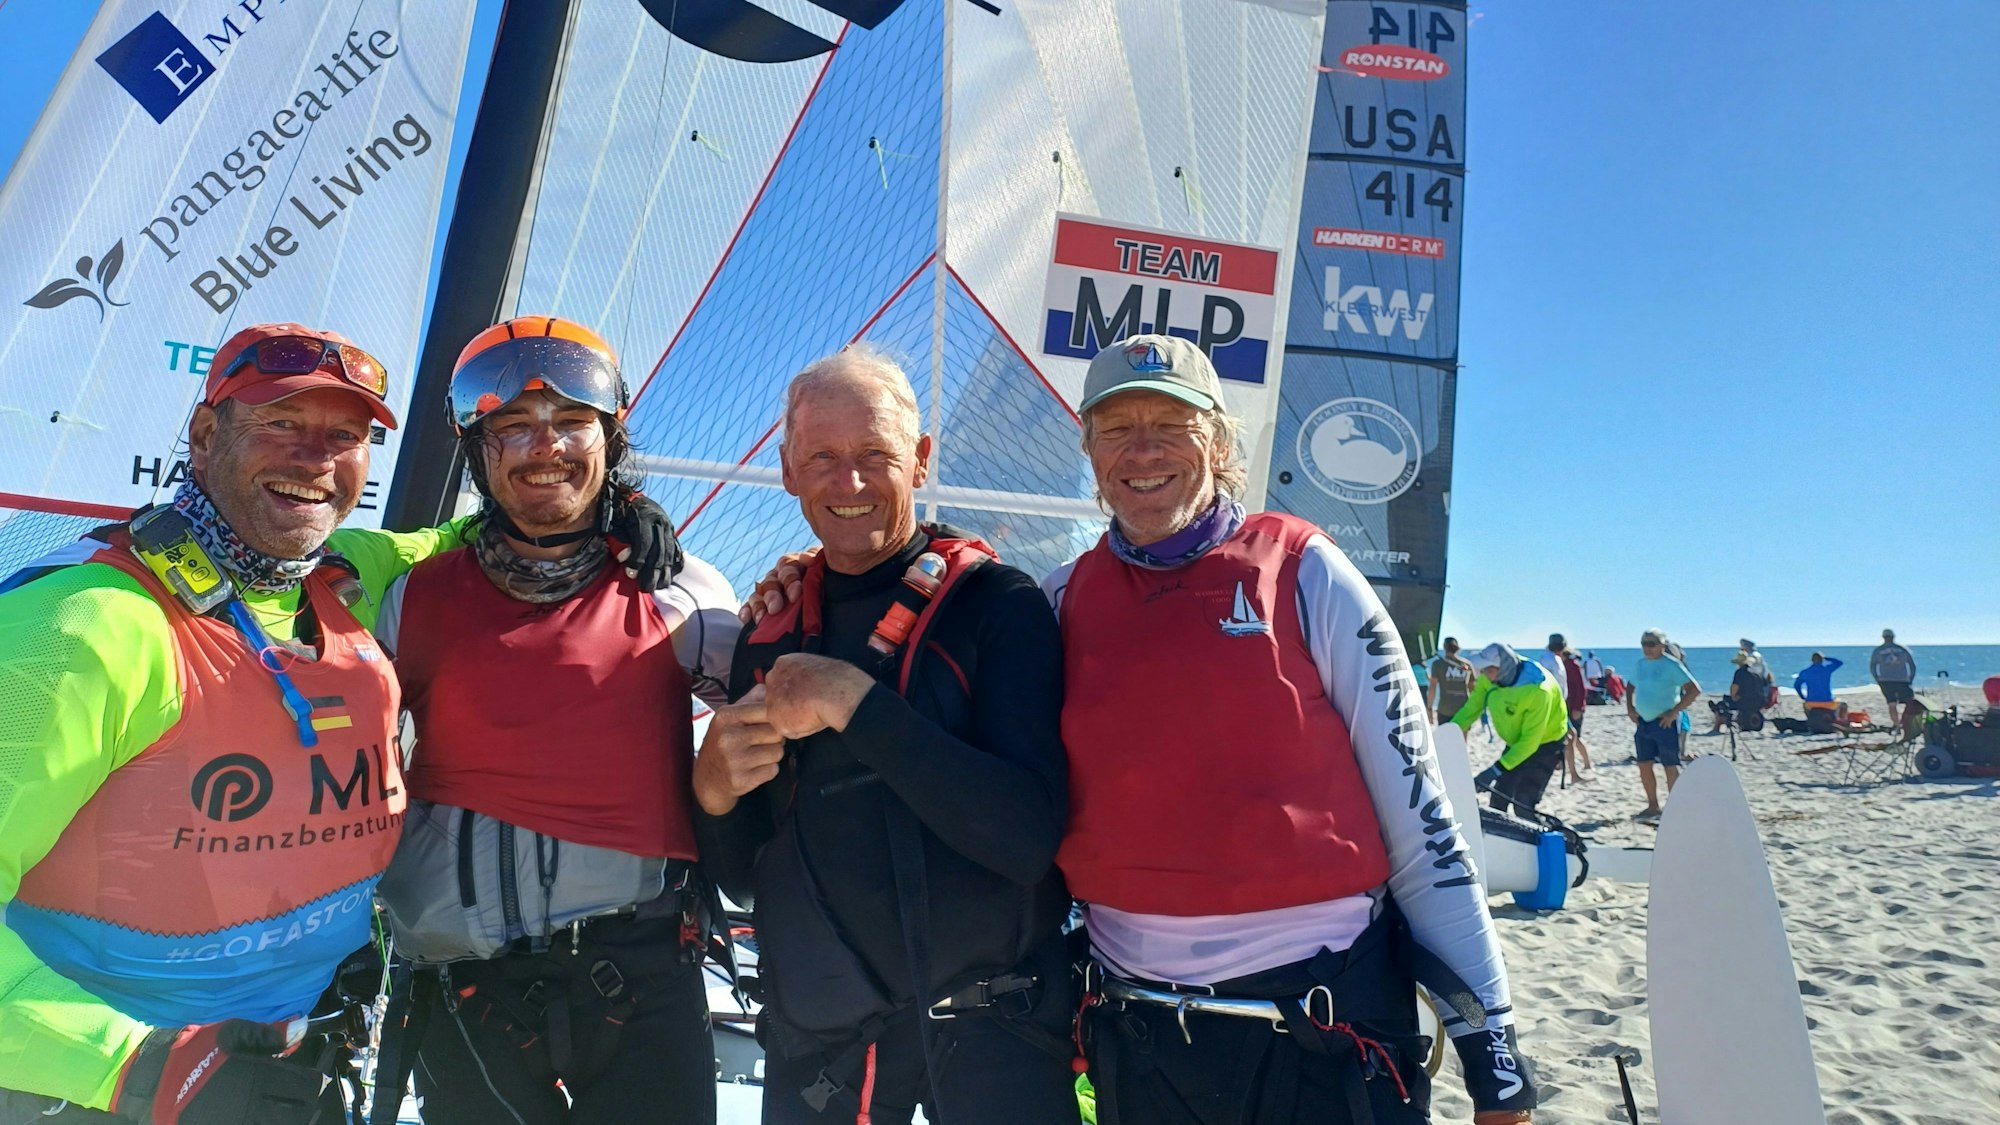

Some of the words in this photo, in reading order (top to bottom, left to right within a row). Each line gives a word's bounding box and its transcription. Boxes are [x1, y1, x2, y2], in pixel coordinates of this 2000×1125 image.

[1345, 52, 1444, 75] RONSTAN
[1344, 105, 1455, 159] USA
[189, 226, 299, 314] Blue
[289, 113, 432, 231] Living
[1365, 170, 1453, 223] 414
[1115, 239, 1221, 284] TEAM
[164, 340, 218, 376] TE
[132, 455, 188, 488] HA
[1327, 524, 1364, 537] RAY
[1344, 548, 1411, 565] ARTER
